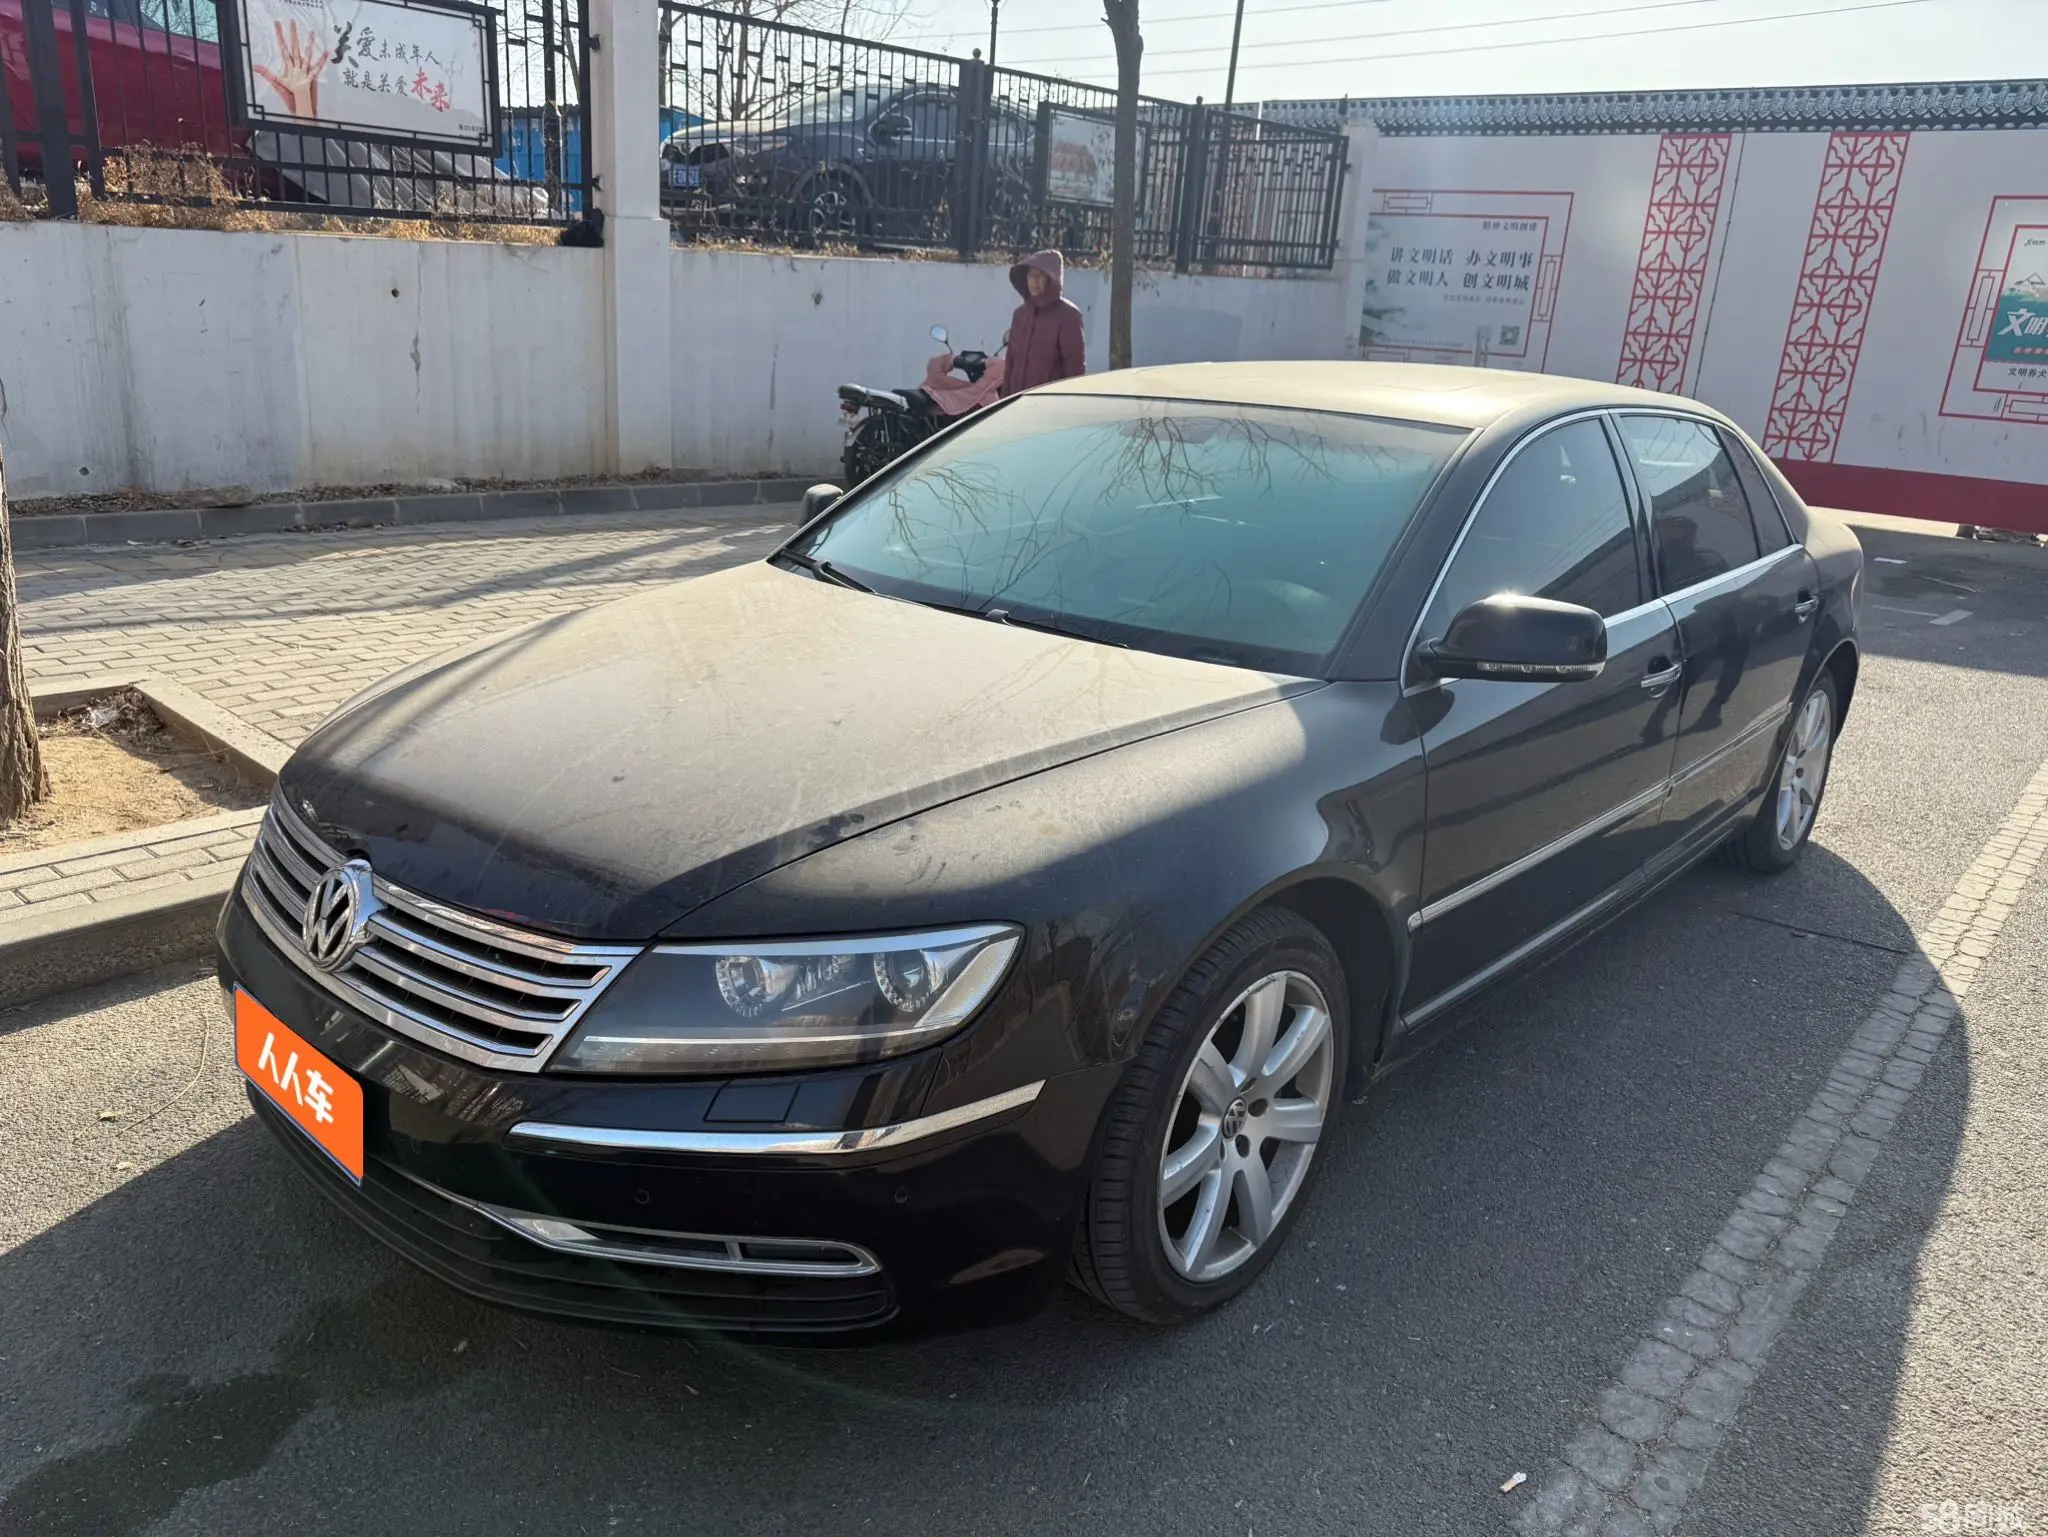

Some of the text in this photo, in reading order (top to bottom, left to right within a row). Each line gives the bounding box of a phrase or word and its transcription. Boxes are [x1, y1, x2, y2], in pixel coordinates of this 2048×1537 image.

[331, 21, 440, 68] 关爱未成年人
[343, 67, 450, 112] 就是关爱未来
[1390, 246, 1534, 268] 讲文明话 办文明事
[1386, 268, 1531, 291] 做文明人 创文明城
[1997, 307, 2048, 338] 文明
